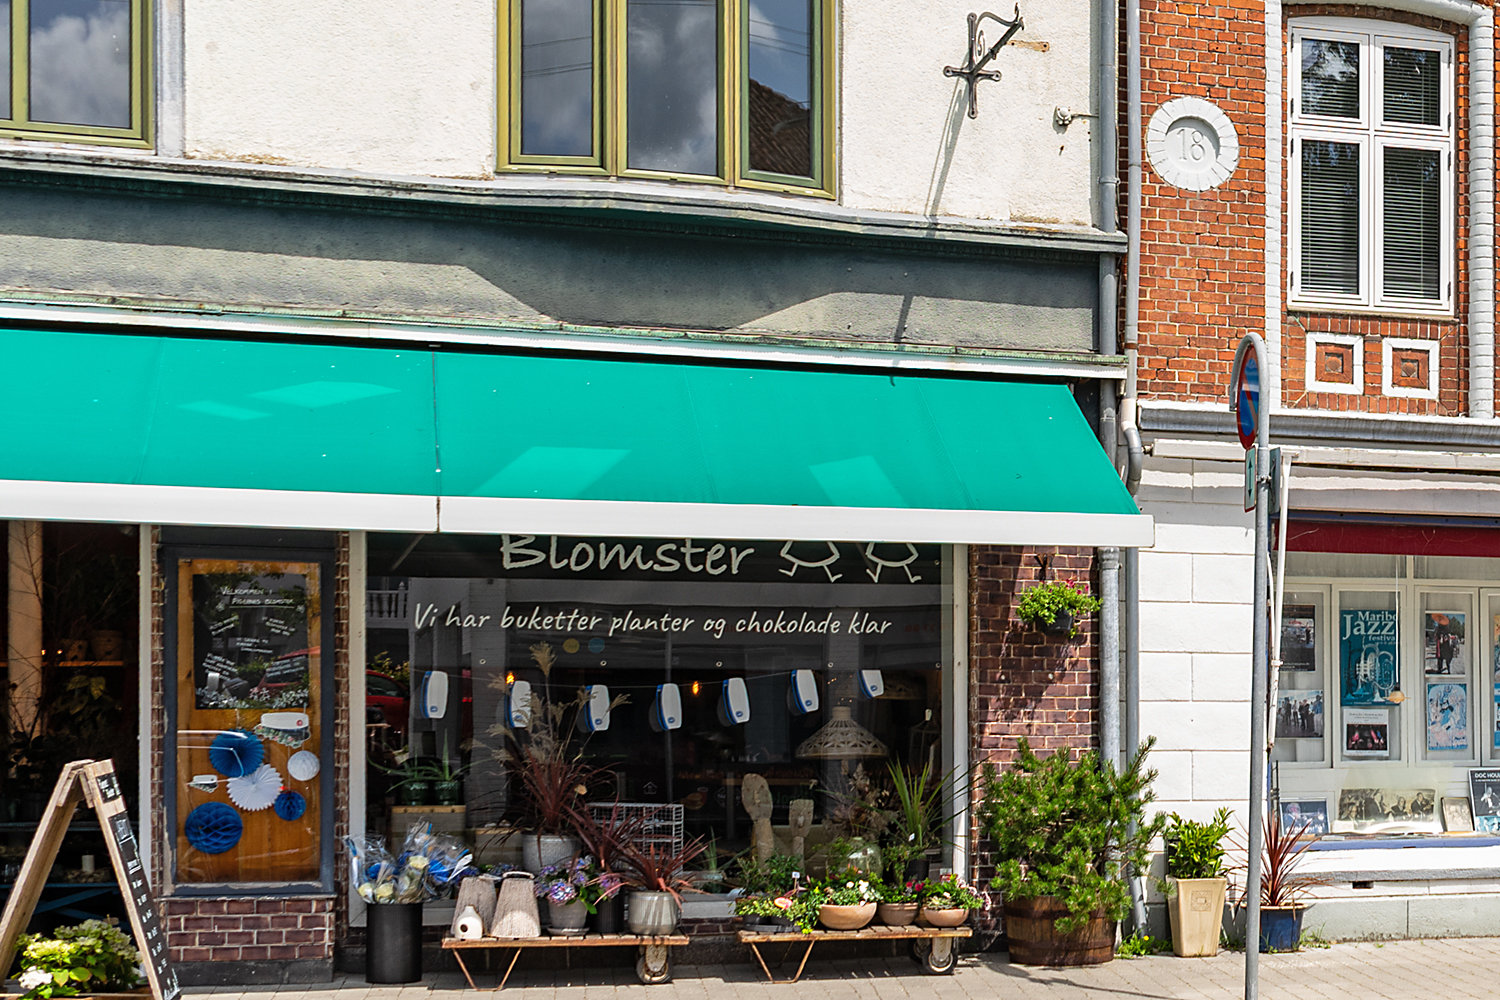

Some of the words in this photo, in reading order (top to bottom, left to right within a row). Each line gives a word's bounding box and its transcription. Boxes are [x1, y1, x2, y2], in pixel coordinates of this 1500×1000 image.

[1177, 128, 1205, 162] 18
[500, 534, 754, 575] Blomster
[415, 602, 438, 629] Vi
[445, 604, 491, 628] har
[501, 606, 602, 631] buketter
[609, 610, 694, 636] planter
[703, 619, 726, 638] og
[735, 610, 841, 634] chokolade
[848, 611, 892, 634] klar
[1342, 614, 1395, 640] Jazz
